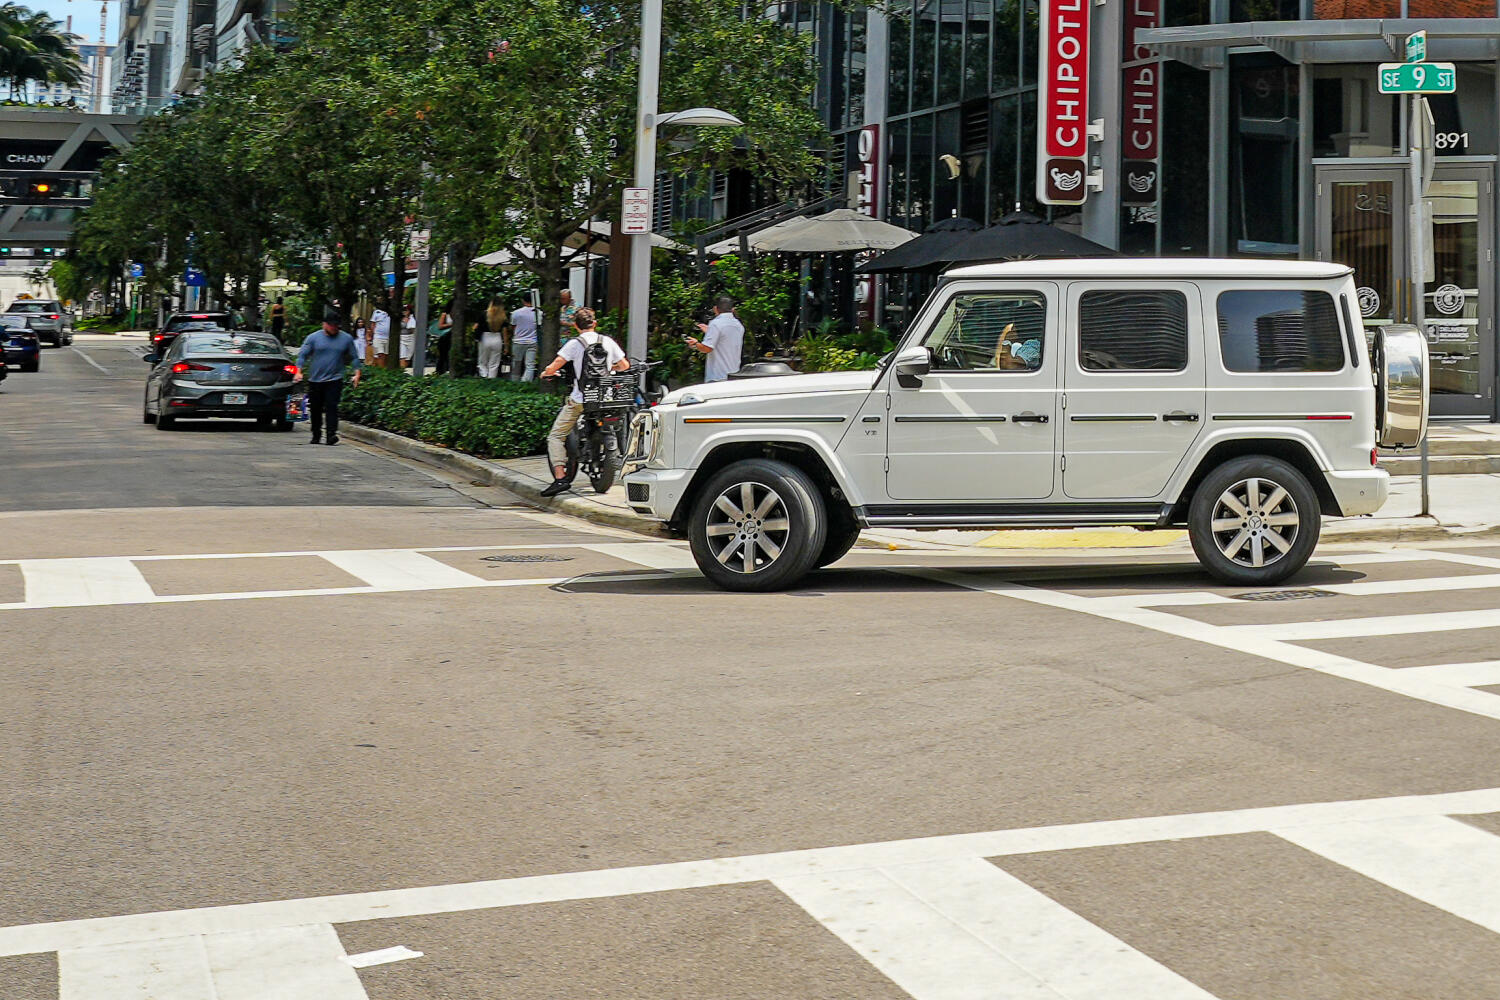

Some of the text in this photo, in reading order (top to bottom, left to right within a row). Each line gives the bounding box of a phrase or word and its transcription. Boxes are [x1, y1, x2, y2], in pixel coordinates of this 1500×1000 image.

[1383, 66, 1453, 89] SE 9 ST
[1435, 132, 1469, 149] 891
